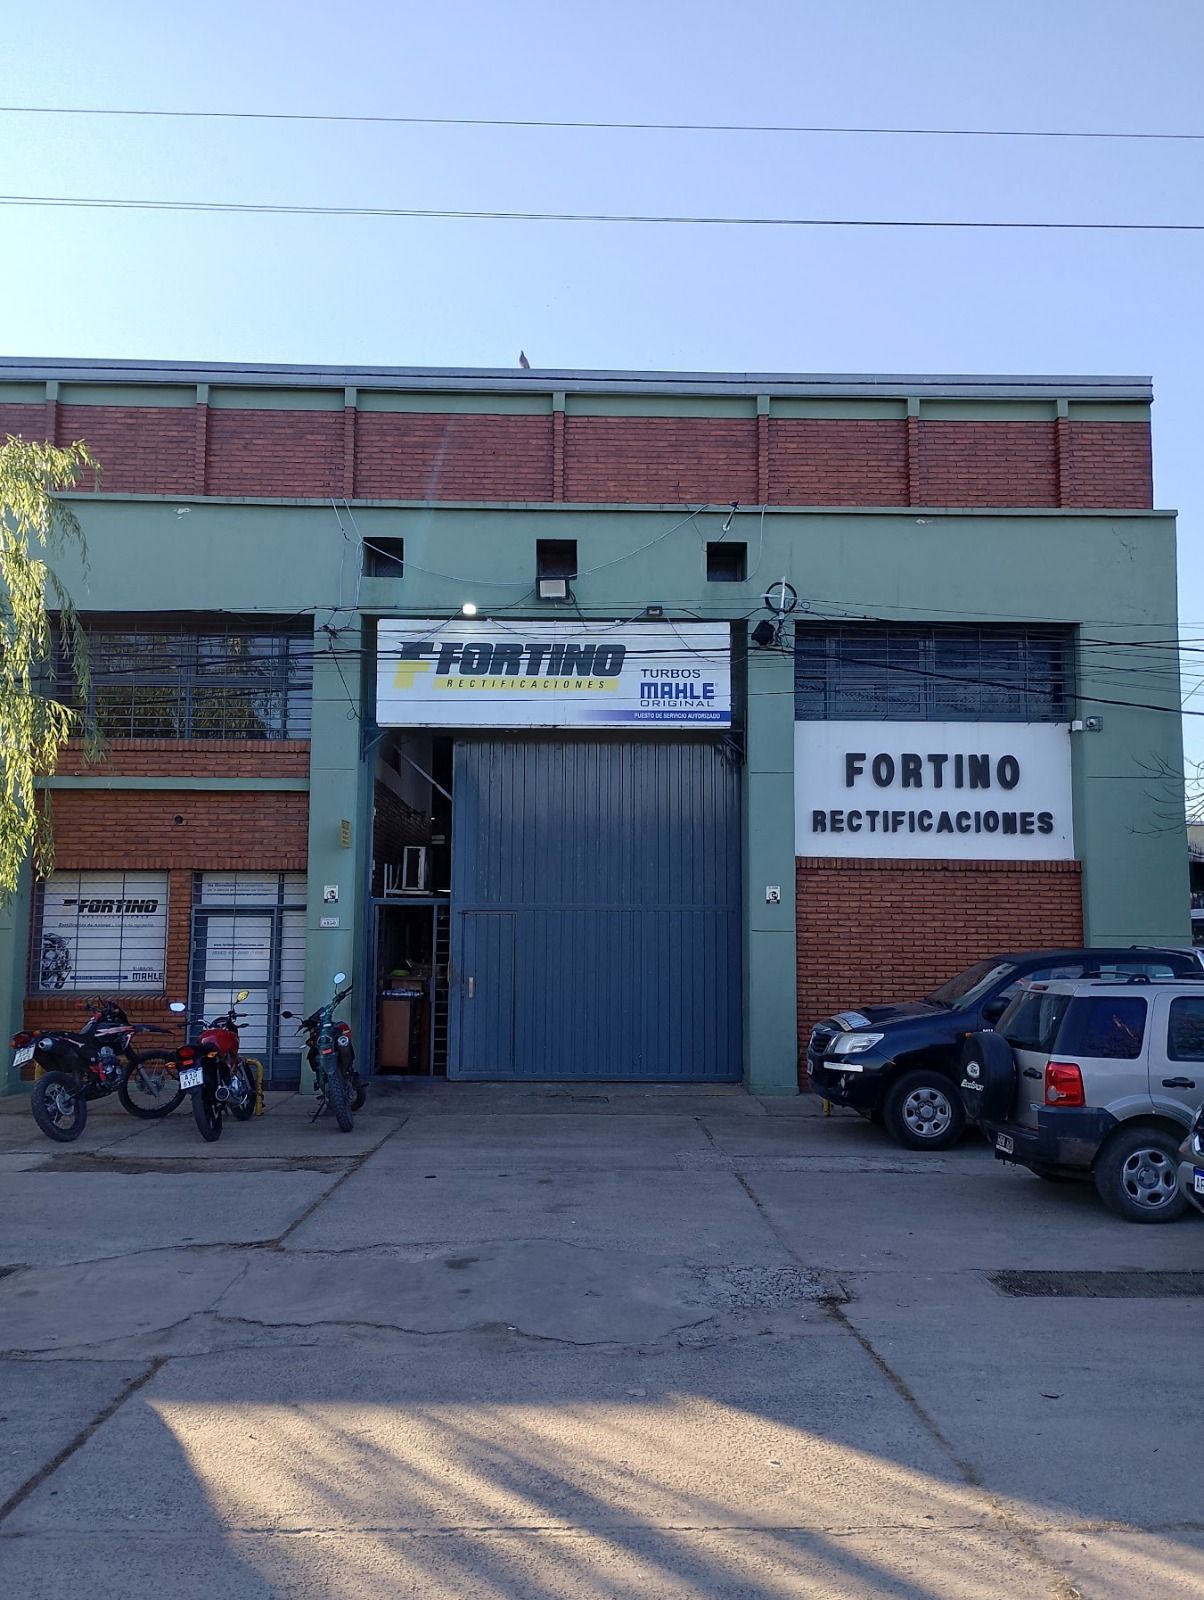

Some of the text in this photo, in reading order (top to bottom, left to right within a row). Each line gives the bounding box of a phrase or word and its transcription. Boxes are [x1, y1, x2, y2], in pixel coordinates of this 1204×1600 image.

[436, 642, 626, 676] FORTINO
[640, 668, 701, 679] TURBOS
[447, 679, 605, 689] RECTIFICACIONES
[640, 682, 715, 700] MAHLE
[845, 752, 1020, 790] FORTINO
[812, 809, 1054, 835] RECTIFICACIONES
[78, 899, 159, 914] FORTINO
[132, 972, 164, 981] MAHLE
